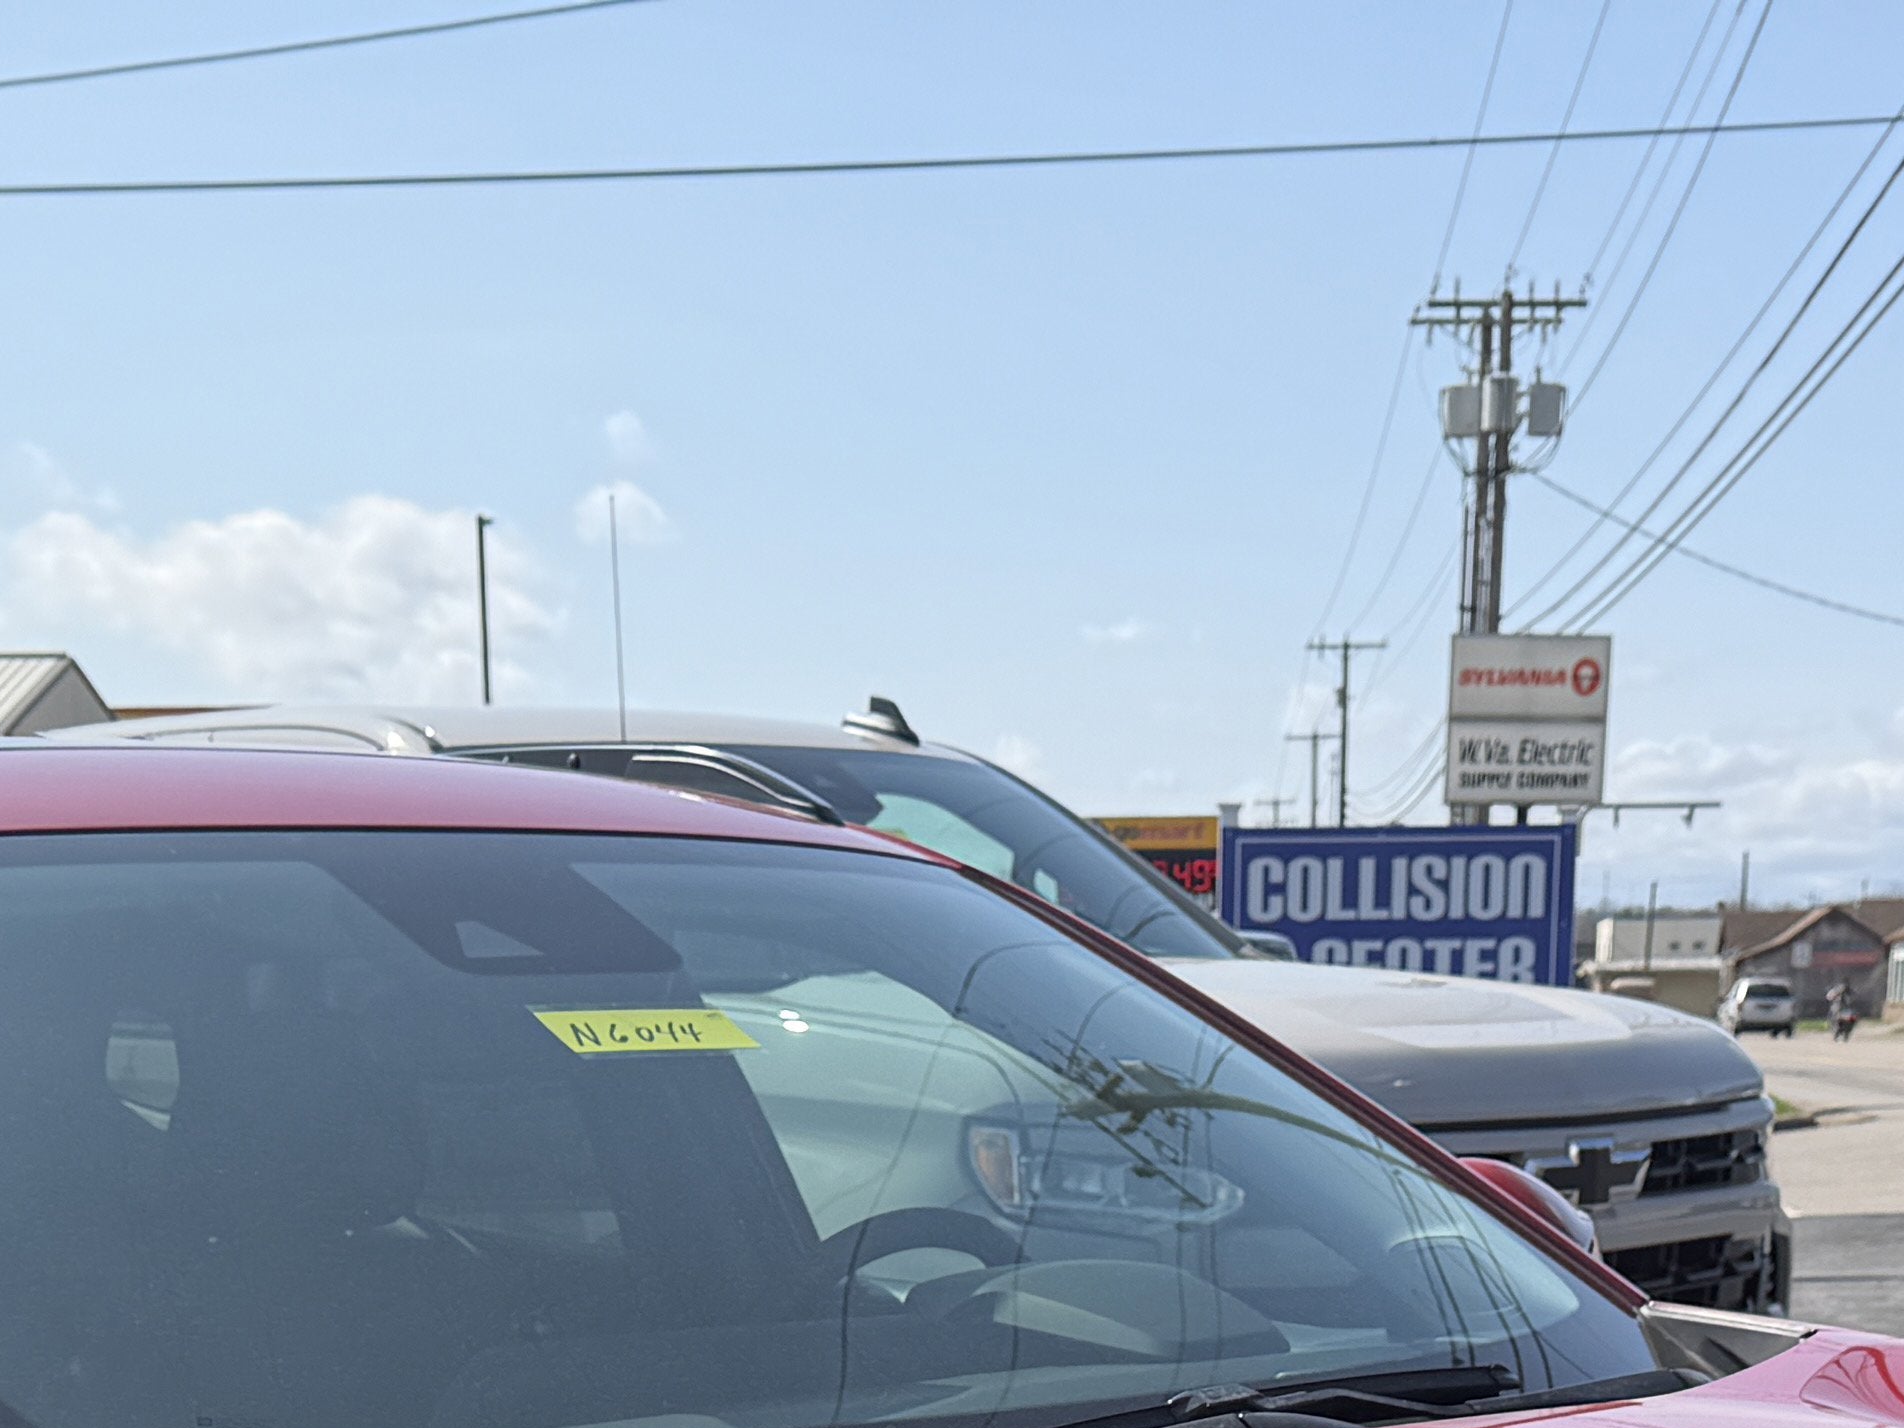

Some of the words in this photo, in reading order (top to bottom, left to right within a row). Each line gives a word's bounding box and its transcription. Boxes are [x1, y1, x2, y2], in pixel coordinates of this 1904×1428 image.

[1517, 737, 1594, 766] Electric
[1516, 771, 1591, 789] COMPANY
[1247, 855, 1547, 922] COLLISION
[569, 1021, 702, 1047] N6044
